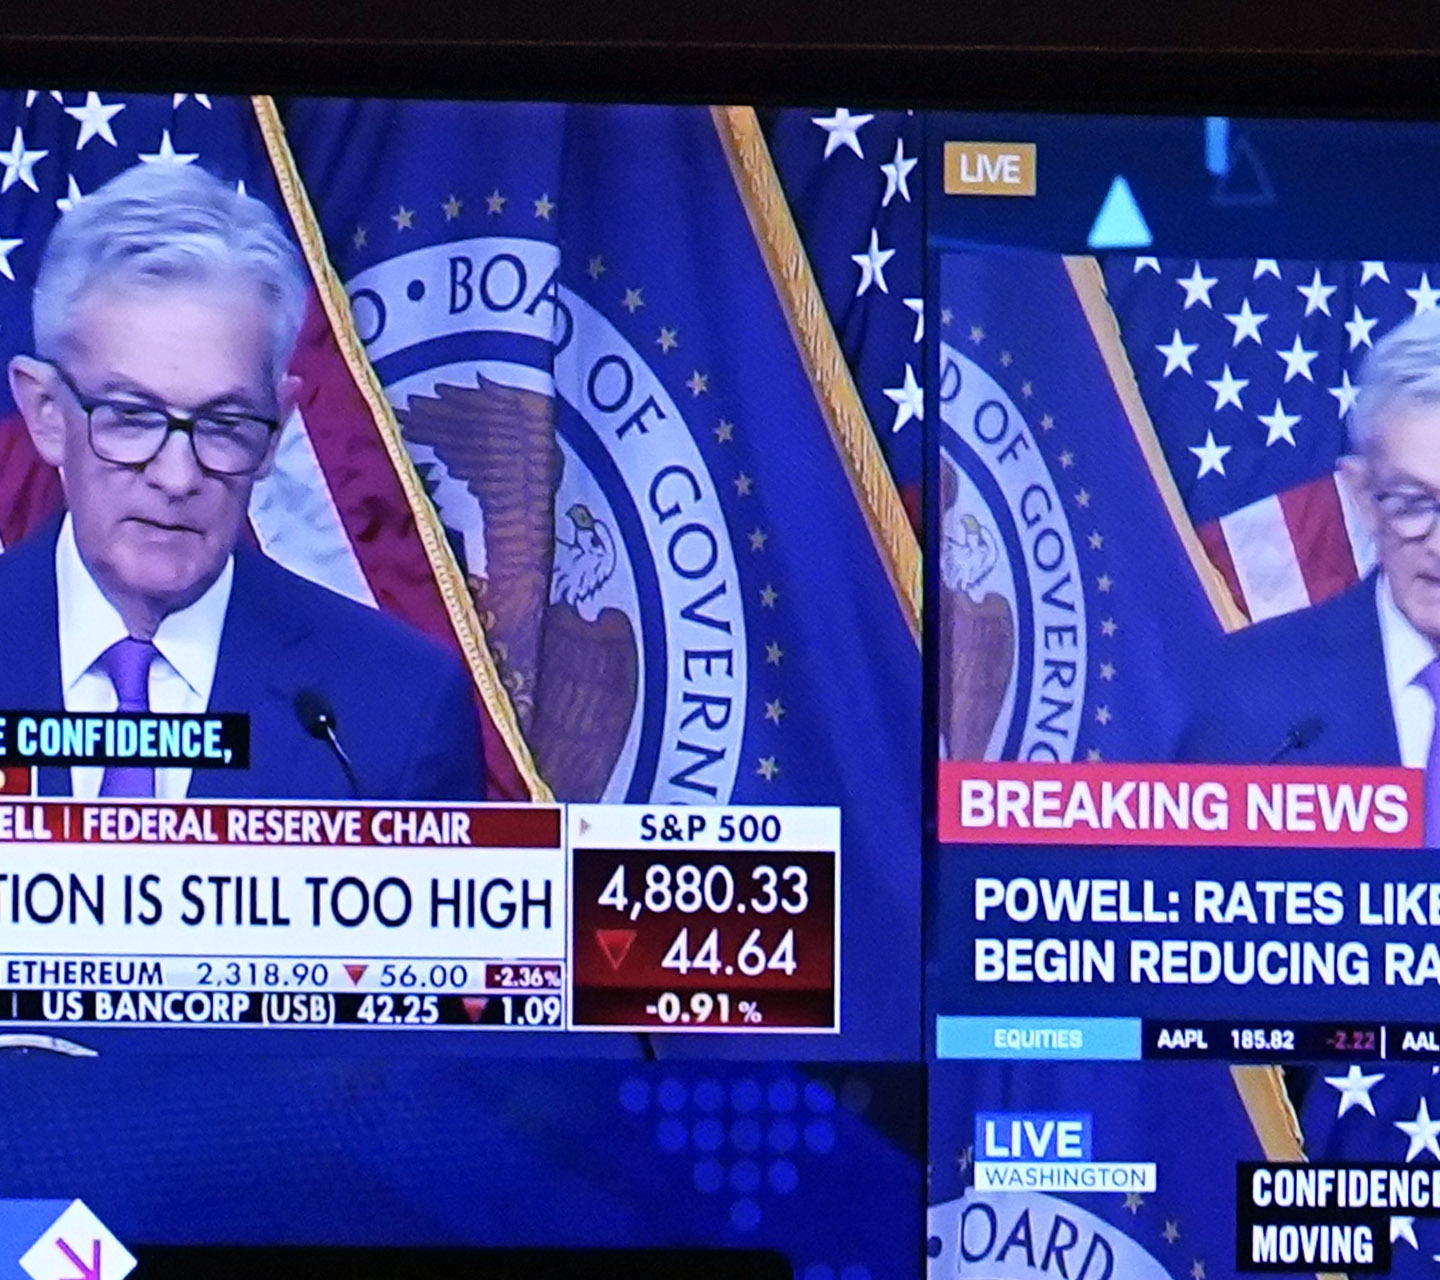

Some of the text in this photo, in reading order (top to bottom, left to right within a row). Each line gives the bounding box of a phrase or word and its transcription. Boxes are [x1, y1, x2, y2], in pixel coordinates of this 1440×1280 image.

[959, 154, 1021, 185] LIVE
[16, 716, 233, 763] CONFIDENCE,
[81, 805, 219, 842] FEDERAL
[226, 807, 362, 844] RESERVE
[370, 810, 472, 845] CHAIR
[959, 778, 1409, 834] BREAKING NEWS
[639, 813, 782, 844] S&P 500
[124, 873, 163, 927] IS
[181, 874, 291, 927] STILL
[304, 876, 413, 928] TOO
[429, 877, 553, 930] HIGH
[597, 864, 810, 921] 4,880.33
[974, 877, 1180, 922] POWELL:
[1193, 880, 1344, 925] RATES
[660, 928, 798, 977] 44.64
[974, 938, 1116, 984] BEGIN
[1129, 940, 1370, 987] REDUCING
[6, 960, 469, 988] ETHEREUM 2,318.90 56.00
[41, 992, 440, 1025] US BANCORP (USB) 42.25
[1157, 1028, 1295, 1051] AAPL 185.82
[984, 1121, 1084, 1158] LIVE
[984, 1166, 1147, 1188] WASHINGTON
[1251, 1224, 1374, 1265] MOVING
